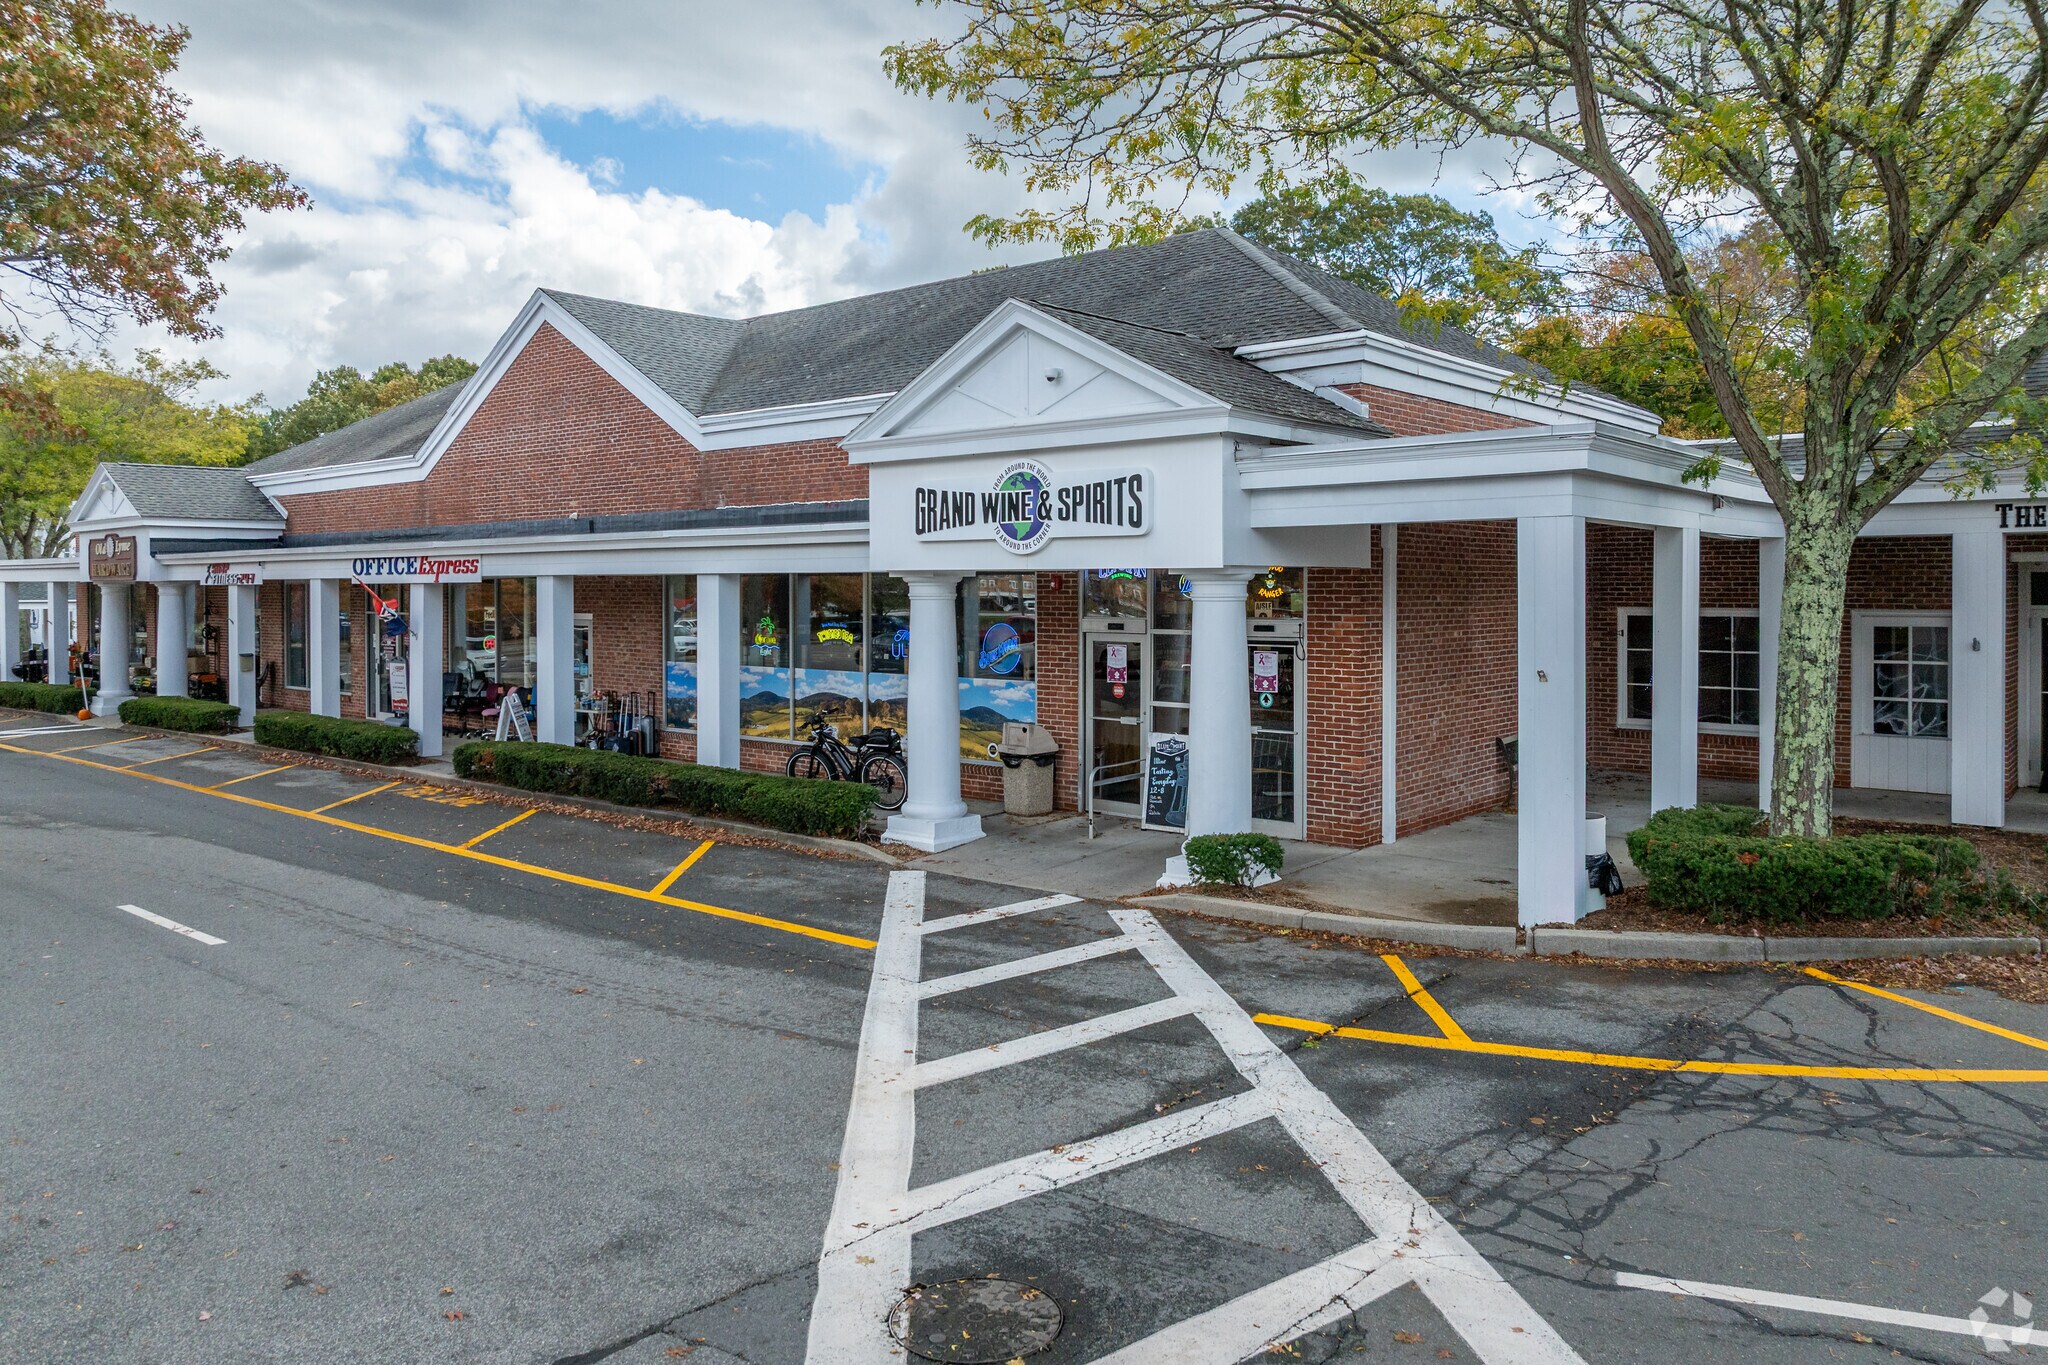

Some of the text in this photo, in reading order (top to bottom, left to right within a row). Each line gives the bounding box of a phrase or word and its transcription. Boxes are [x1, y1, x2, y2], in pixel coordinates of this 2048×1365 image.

[993, 462, 1051, 491] FROM AROUND THE WORLD
[915, 473, 1143, 535] GRAND WINE & SPIRITS
[1994, 503, 2047, 528] THE
[993, 523, 1051, 551] TO AROUND THE CORNER
[95, 540, 131, 555] Old Lyme
[92, 563, 131, 577] HARDWARE
[352, 555, 479, 583] OFFICE Express
[1258, 587, 1284, 599] RANGER
[1255, 602, 1272, 610] AISLE
[1151, 767, 1175, 777] Tasting
